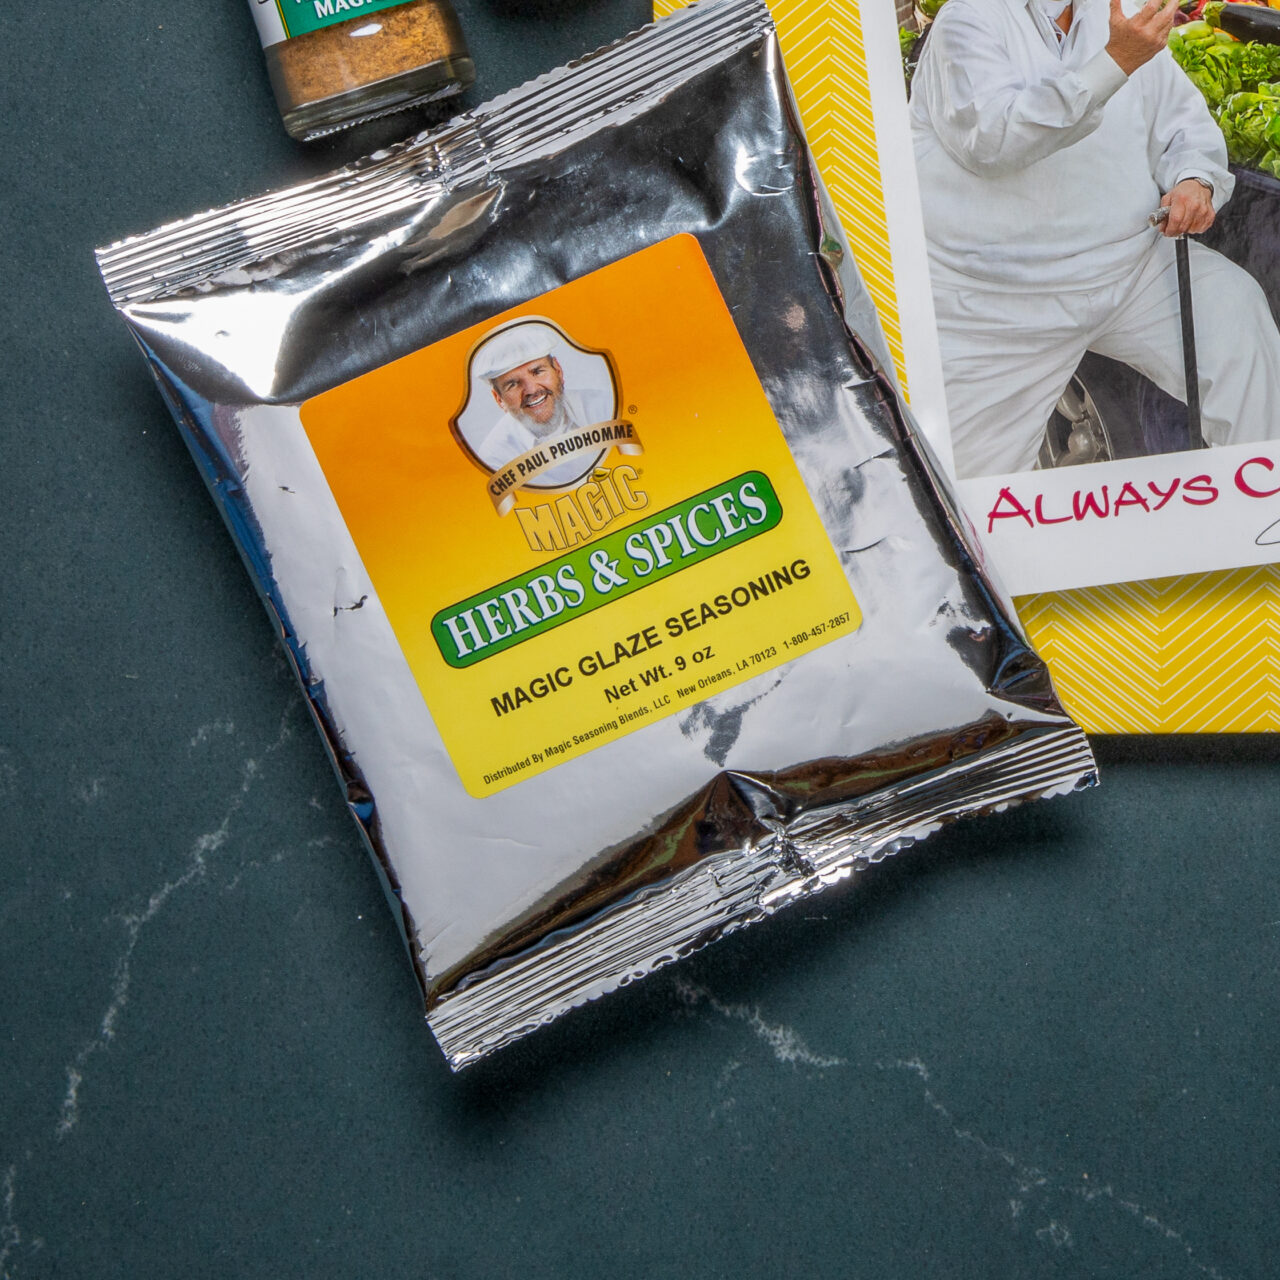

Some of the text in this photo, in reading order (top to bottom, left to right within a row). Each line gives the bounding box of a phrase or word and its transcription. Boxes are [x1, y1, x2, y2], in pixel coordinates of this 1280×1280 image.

[490, 423, 633, 496] CHEF PAUL PRUDHOMME
[987, 475, 1218, 533] ALWAYS
[442, 482, 768, 659] HERBS & SPICES
[490, 558, 812, 717] MAGIC GLAZE SEASONING
[603, 645, 717, 703] Net Wt. 9 oz
[483, 611, 851, 785] Distributed By Magic Seasoning Blends, LLC New Orleans, LA 70123 1-800-457-2857
